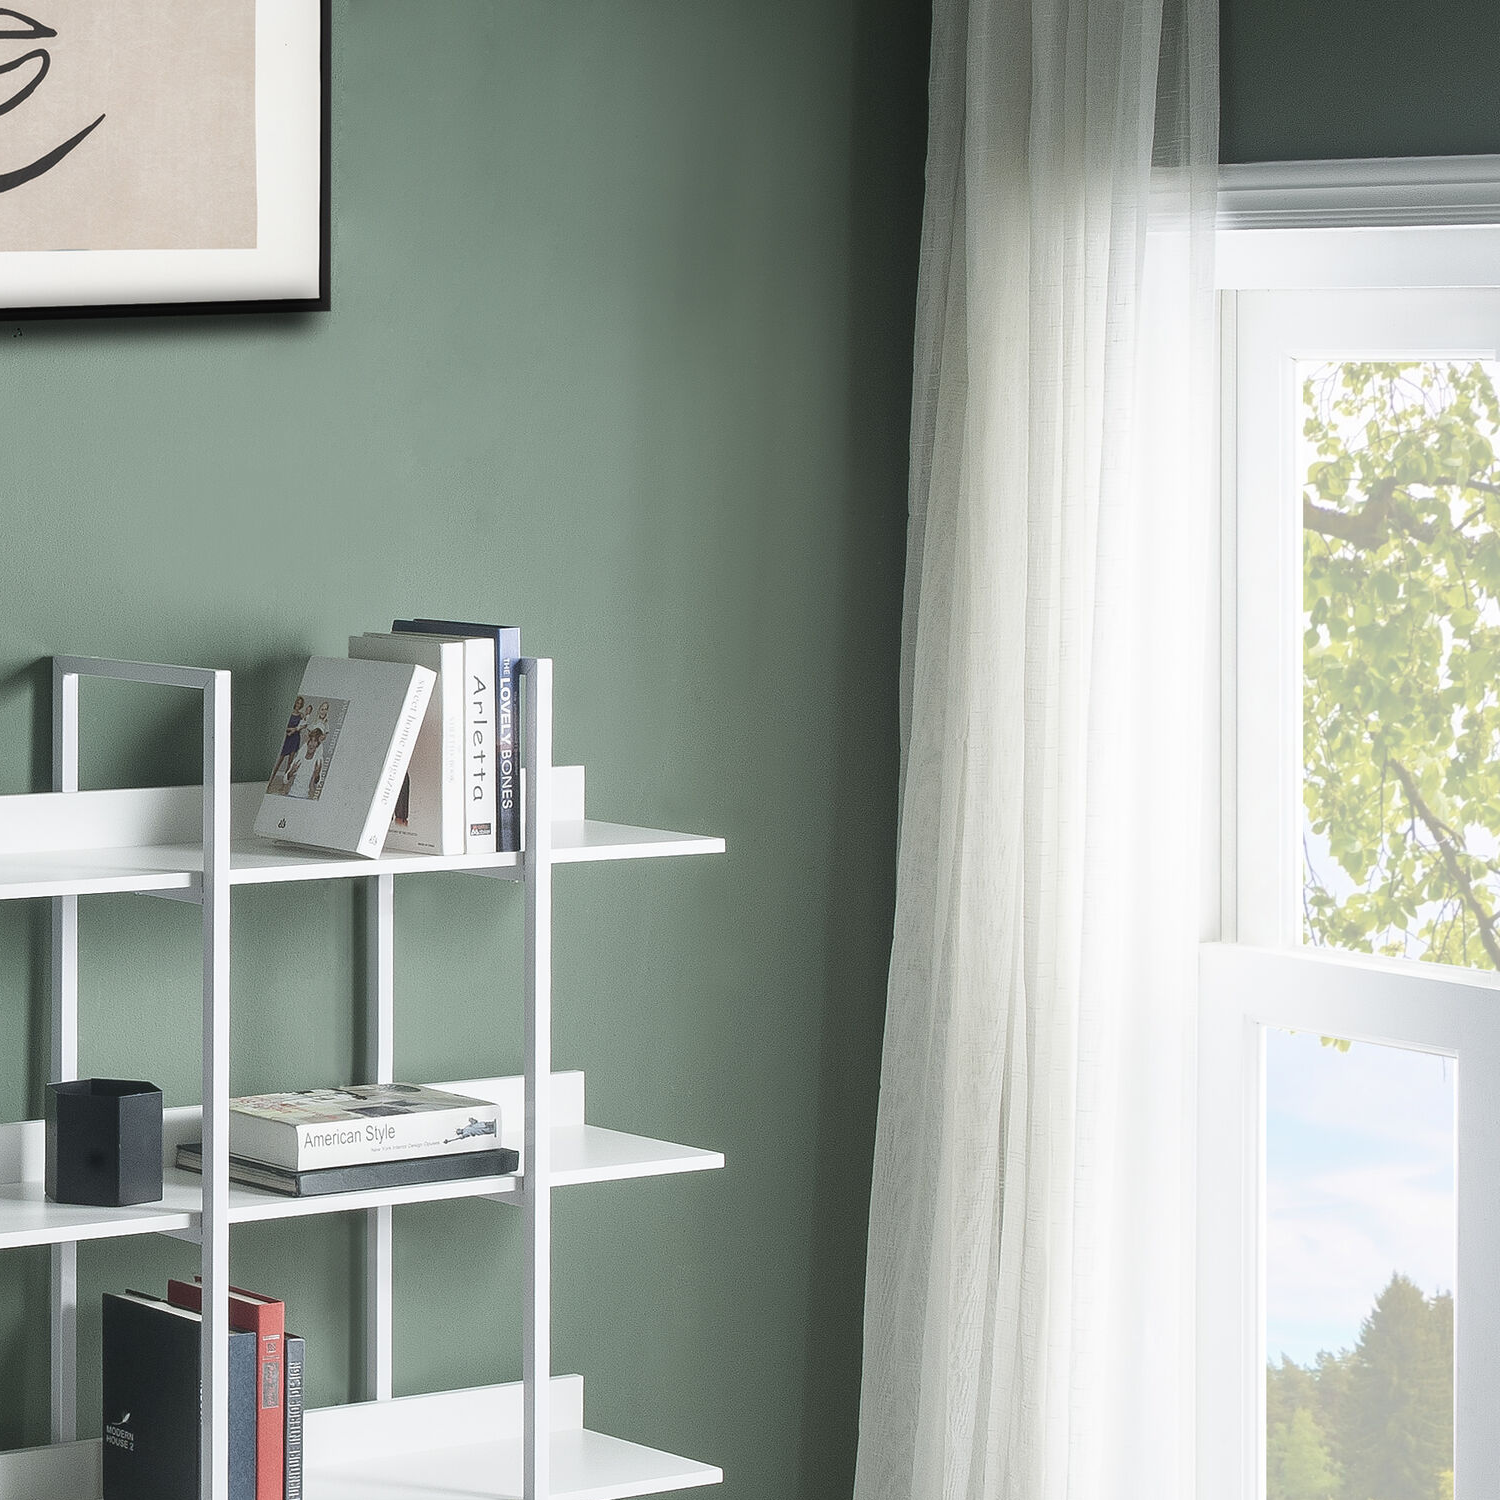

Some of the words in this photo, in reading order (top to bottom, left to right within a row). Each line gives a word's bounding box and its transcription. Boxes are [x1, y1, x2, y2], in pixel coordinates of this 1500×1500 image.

[503, 657, 511, 676] THE
[500, 678, 511, 746] LOVELY
[472, 675, 488, 801] Arletta
[501, 748, 513, 810] BONES
[303, 1129, 362, 1149] American
[365, 1123, 396, 1144] Style
[288, 1361, 301, 1398] DESIGN
[106, 1424, 134, 1441] MODERN
[288, 1400, 301, 1445] INTERIOR
[106, 1434, 129, 1449] HOUSE
